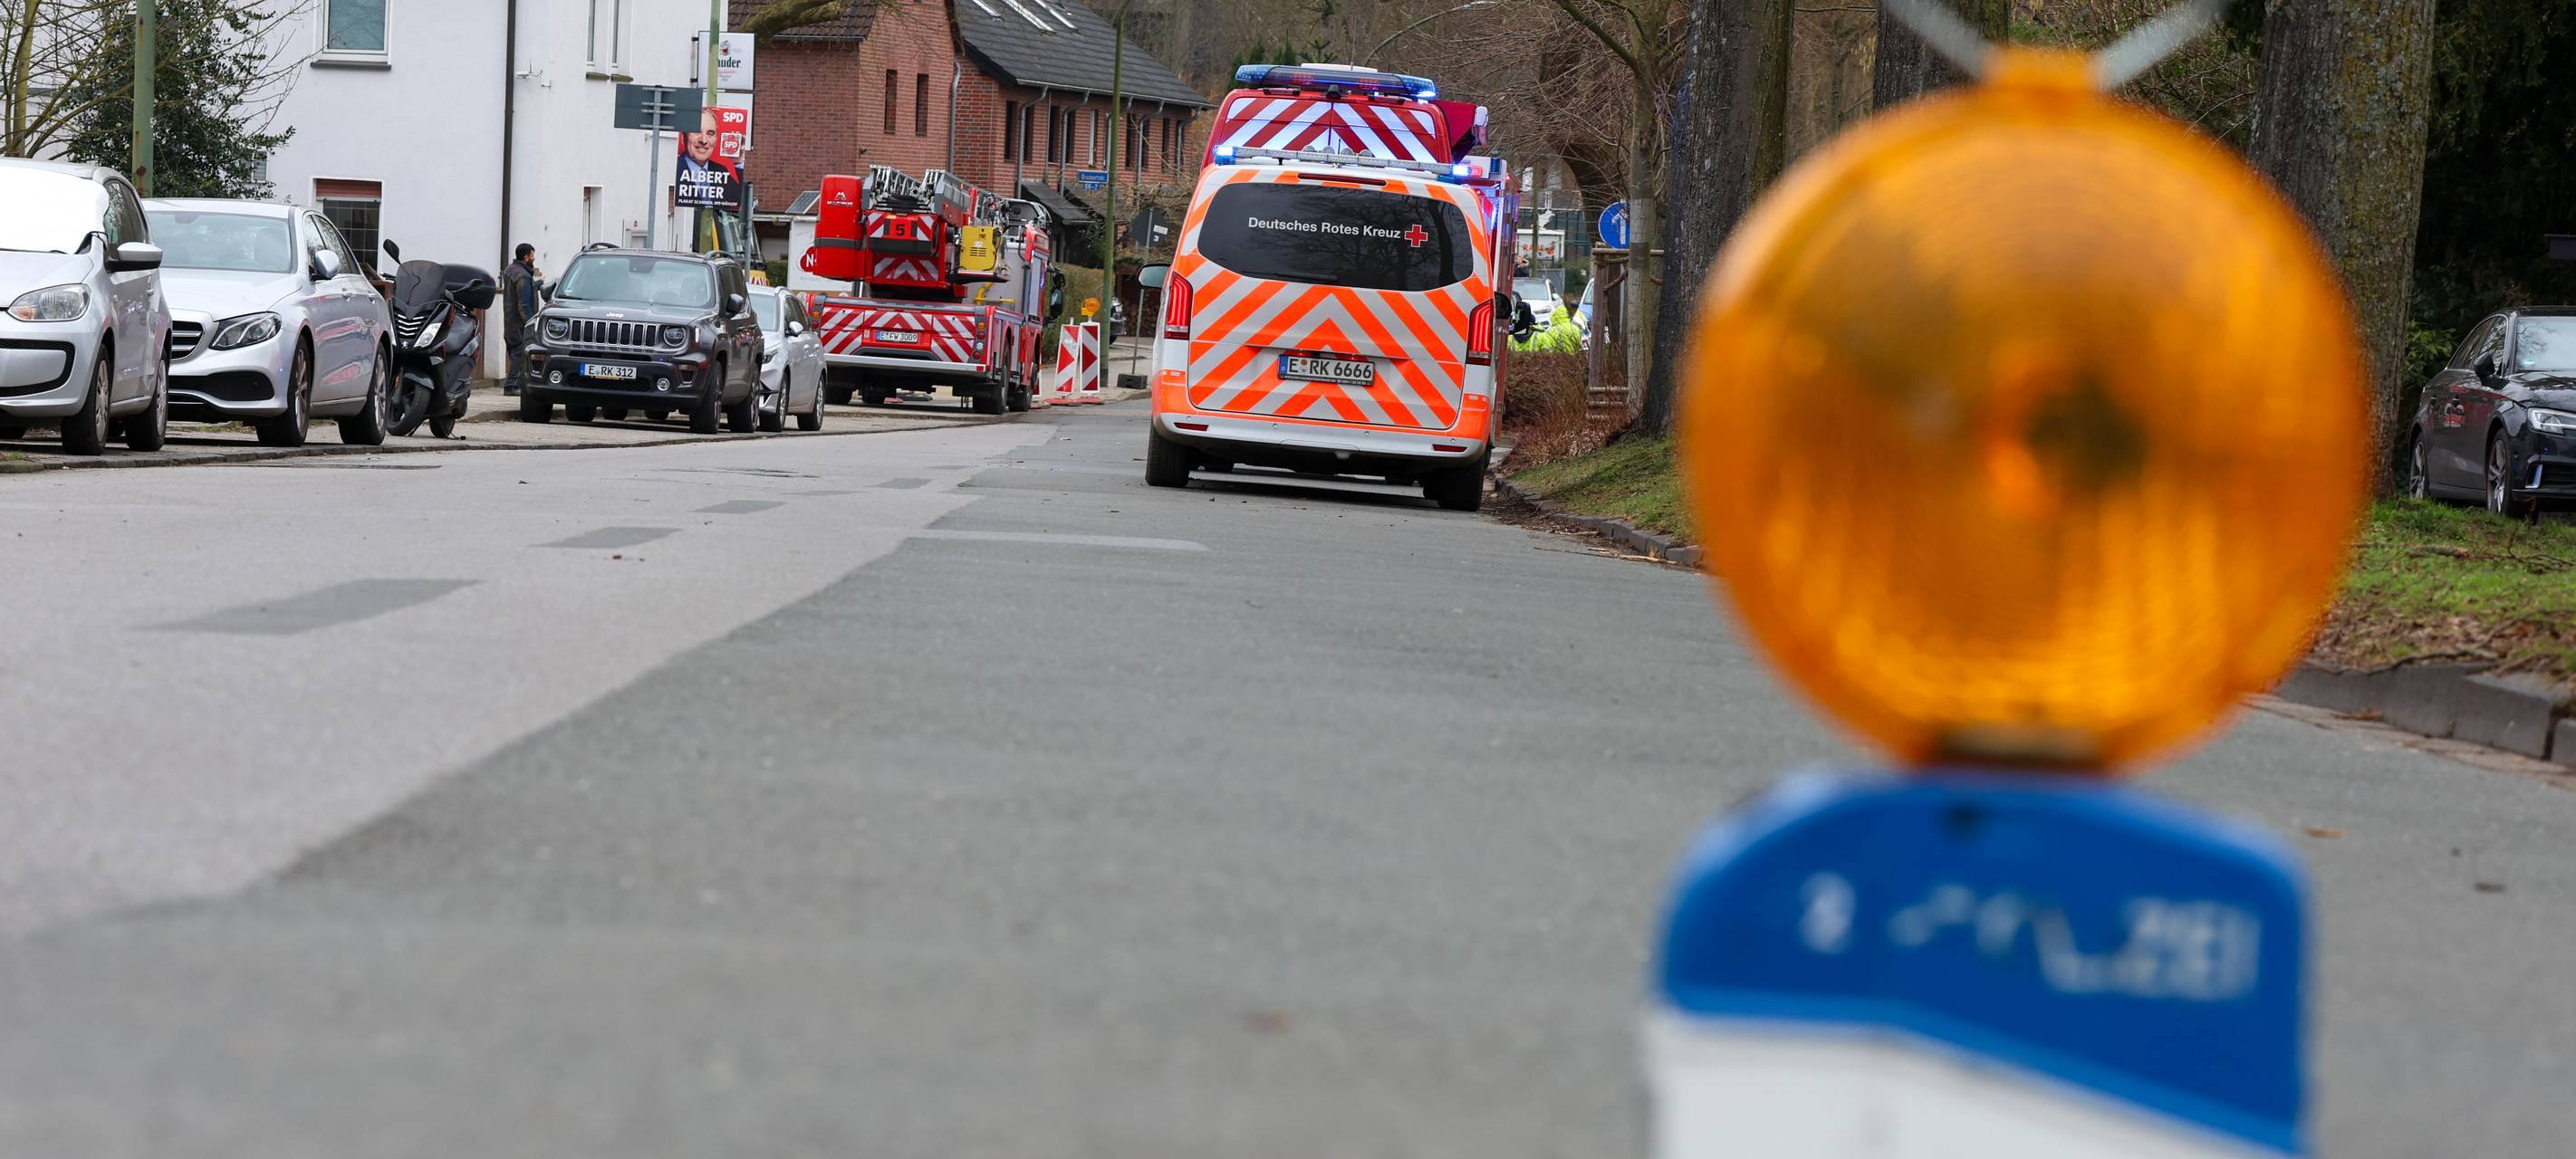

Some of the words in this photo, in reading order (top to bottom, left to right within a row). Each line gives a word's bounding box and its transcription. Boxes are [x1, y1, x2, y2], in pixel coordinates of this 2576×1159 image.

[723, 111, 744, 123] SPD
[680, 169, 730, 184] ALBERT
[678, 184, 725, 199] RITTER
[896, 224, 906, 236] 5
[1248, 216, 1318, 232] Deutsches
[1321, 222, 1360, 235] Rotes
[1362, 225, 1401, 239] Kreuz
[589, 365, 595, 375] E
[601, 366, 613, 376] RK
[616, 368, 633, 378] 312
[1289, 359, 1299, 373] E
[1309, 359, 1330, 376] RK
[1333, 362, 1372, 378] 6666
